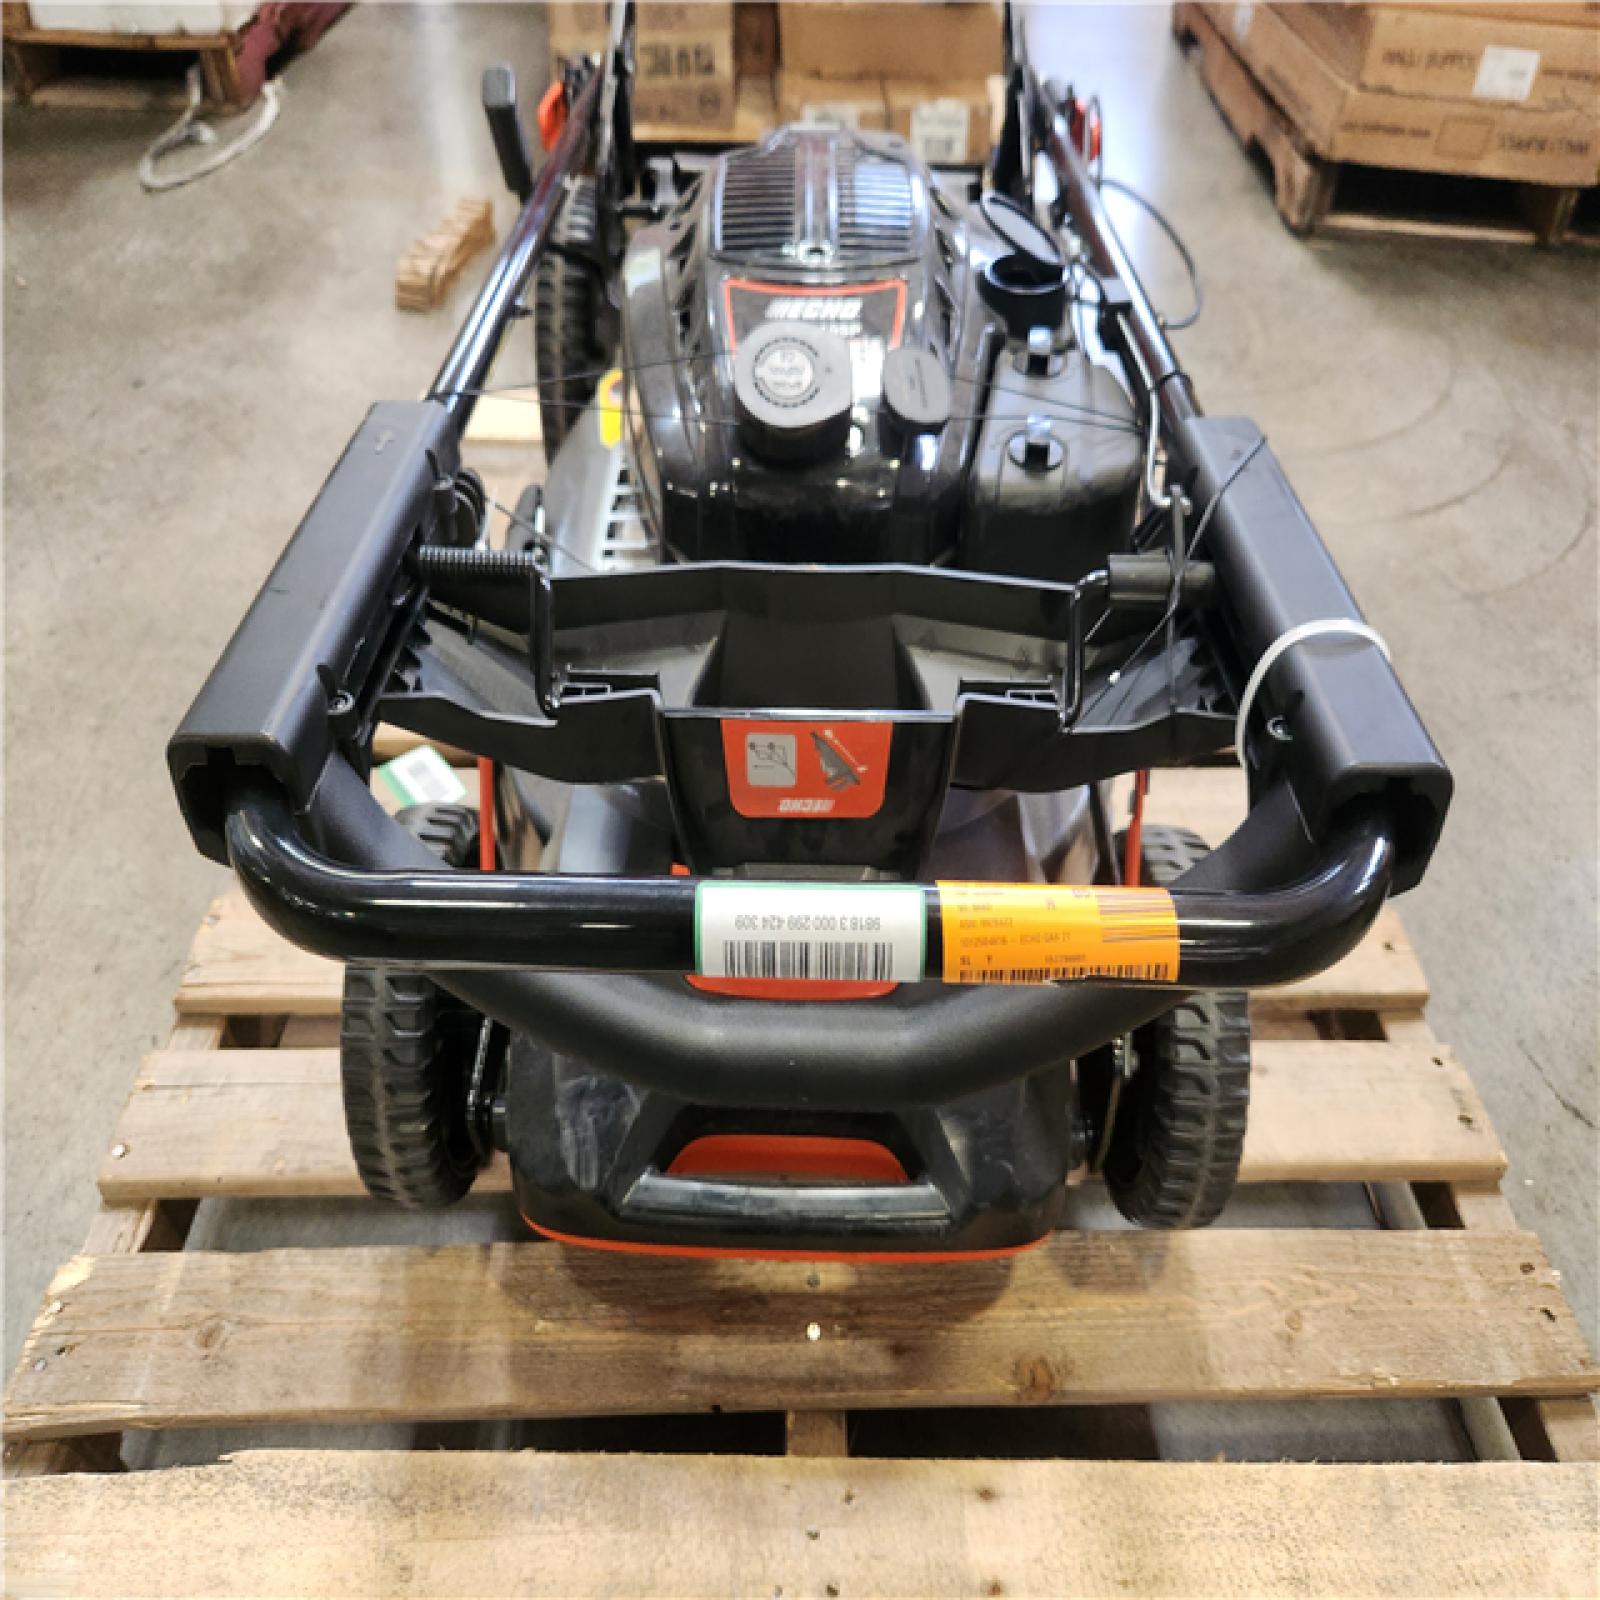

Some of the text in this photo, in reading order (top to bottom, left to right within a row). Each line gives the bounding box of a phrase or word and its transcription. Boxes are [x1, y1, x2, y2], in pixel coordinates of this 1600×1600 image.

[762, 914, 785, 930] 424
[814, 914, 836, 930] 000
[840, 914, 848, 930] 3
[850, 914, 880, 930] 9818
